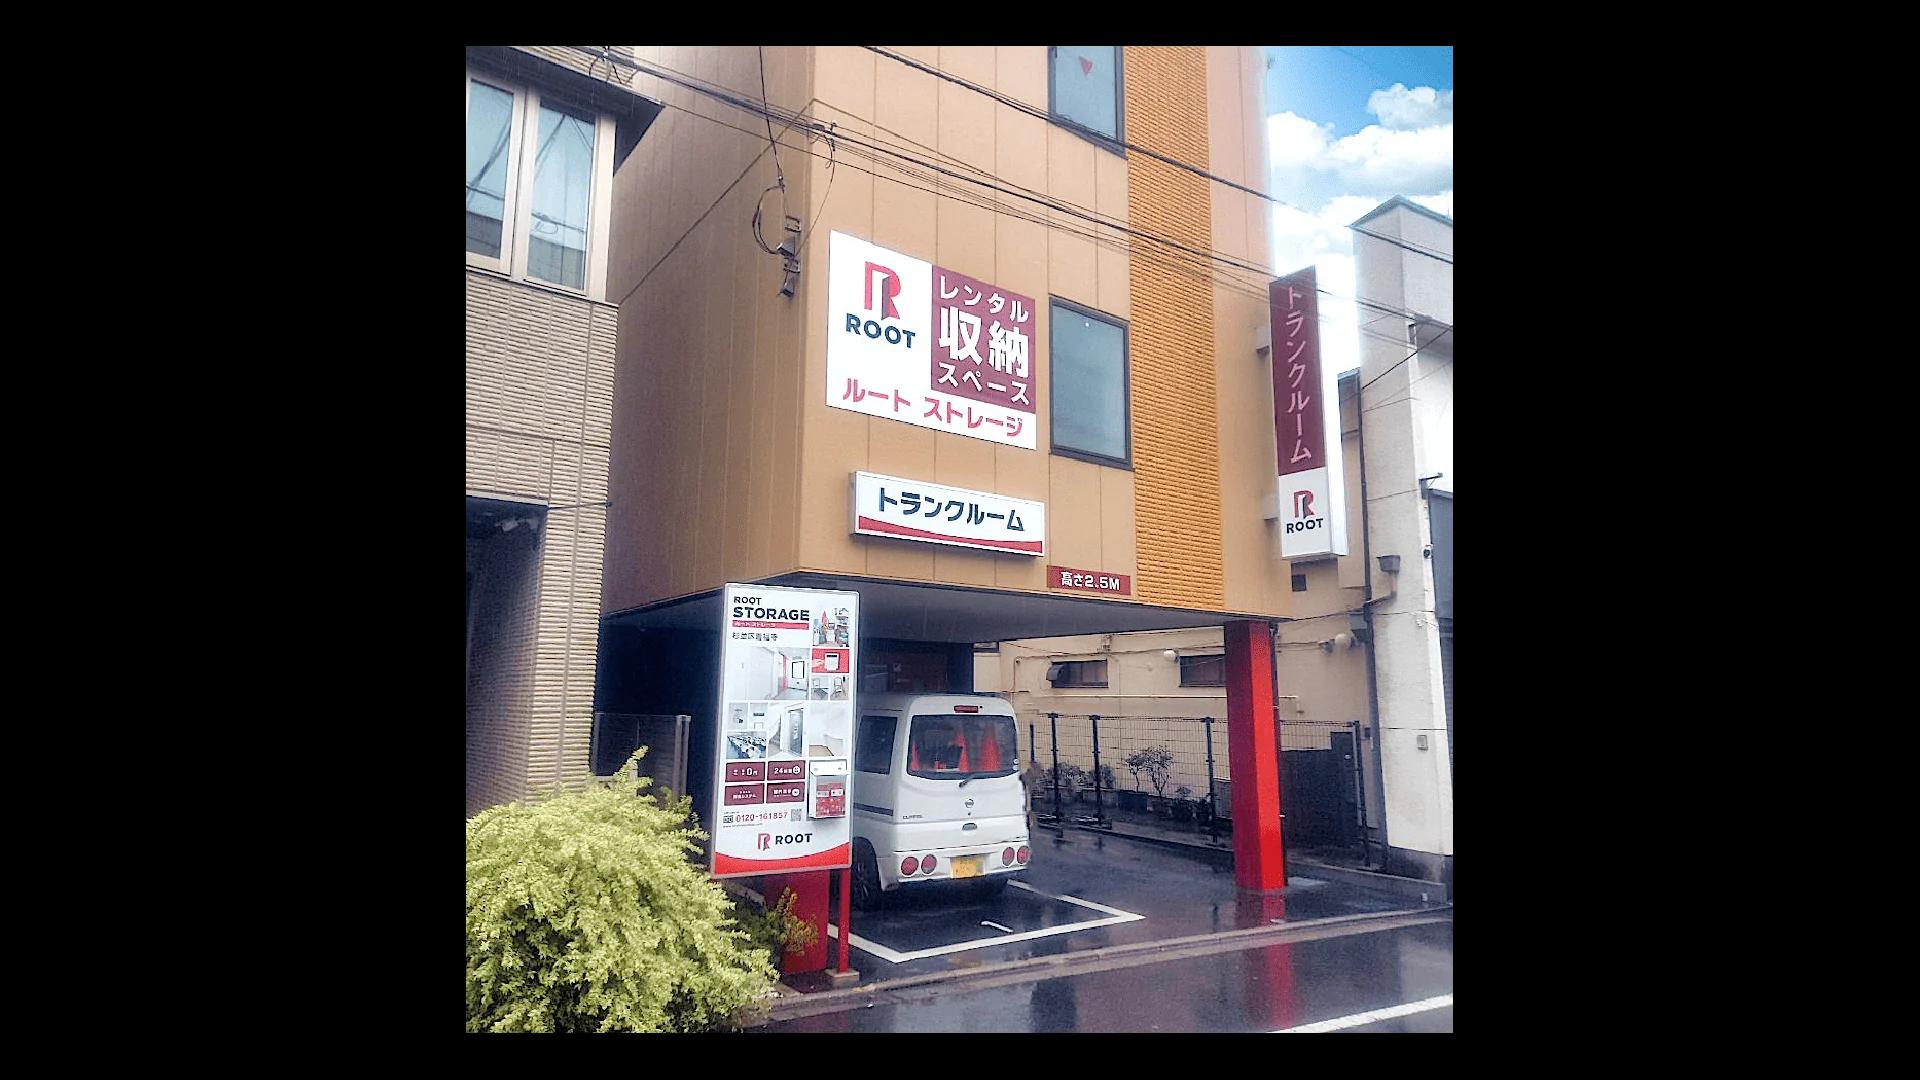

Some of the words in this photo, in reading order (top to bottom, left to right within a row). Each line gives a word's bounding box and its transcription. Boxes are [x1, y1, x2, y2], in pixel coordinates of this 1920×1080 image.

[940, 275, 1029, 323] レンタル
[845, 313, 916, 348] ROOT
[938, 305, 1029, 378] 収納
[938, 362, 1030, 405] スペース
[1285, 286, 1312, 464] トランクルーム
[842, 378, 911, 412] ルート
[923, 396, 1023, 437] ストレージ
[878, 487, 1025, 532] トランクルーム
[1286, 518, 1324, 534] ROOT
[733, 596, 762, 605] ROOT
[1061, 571, 1120, 591] 高さ2.5M
[732, 606, 810, 621] STORAGE
[775, 833, 813, 845] ROOT
